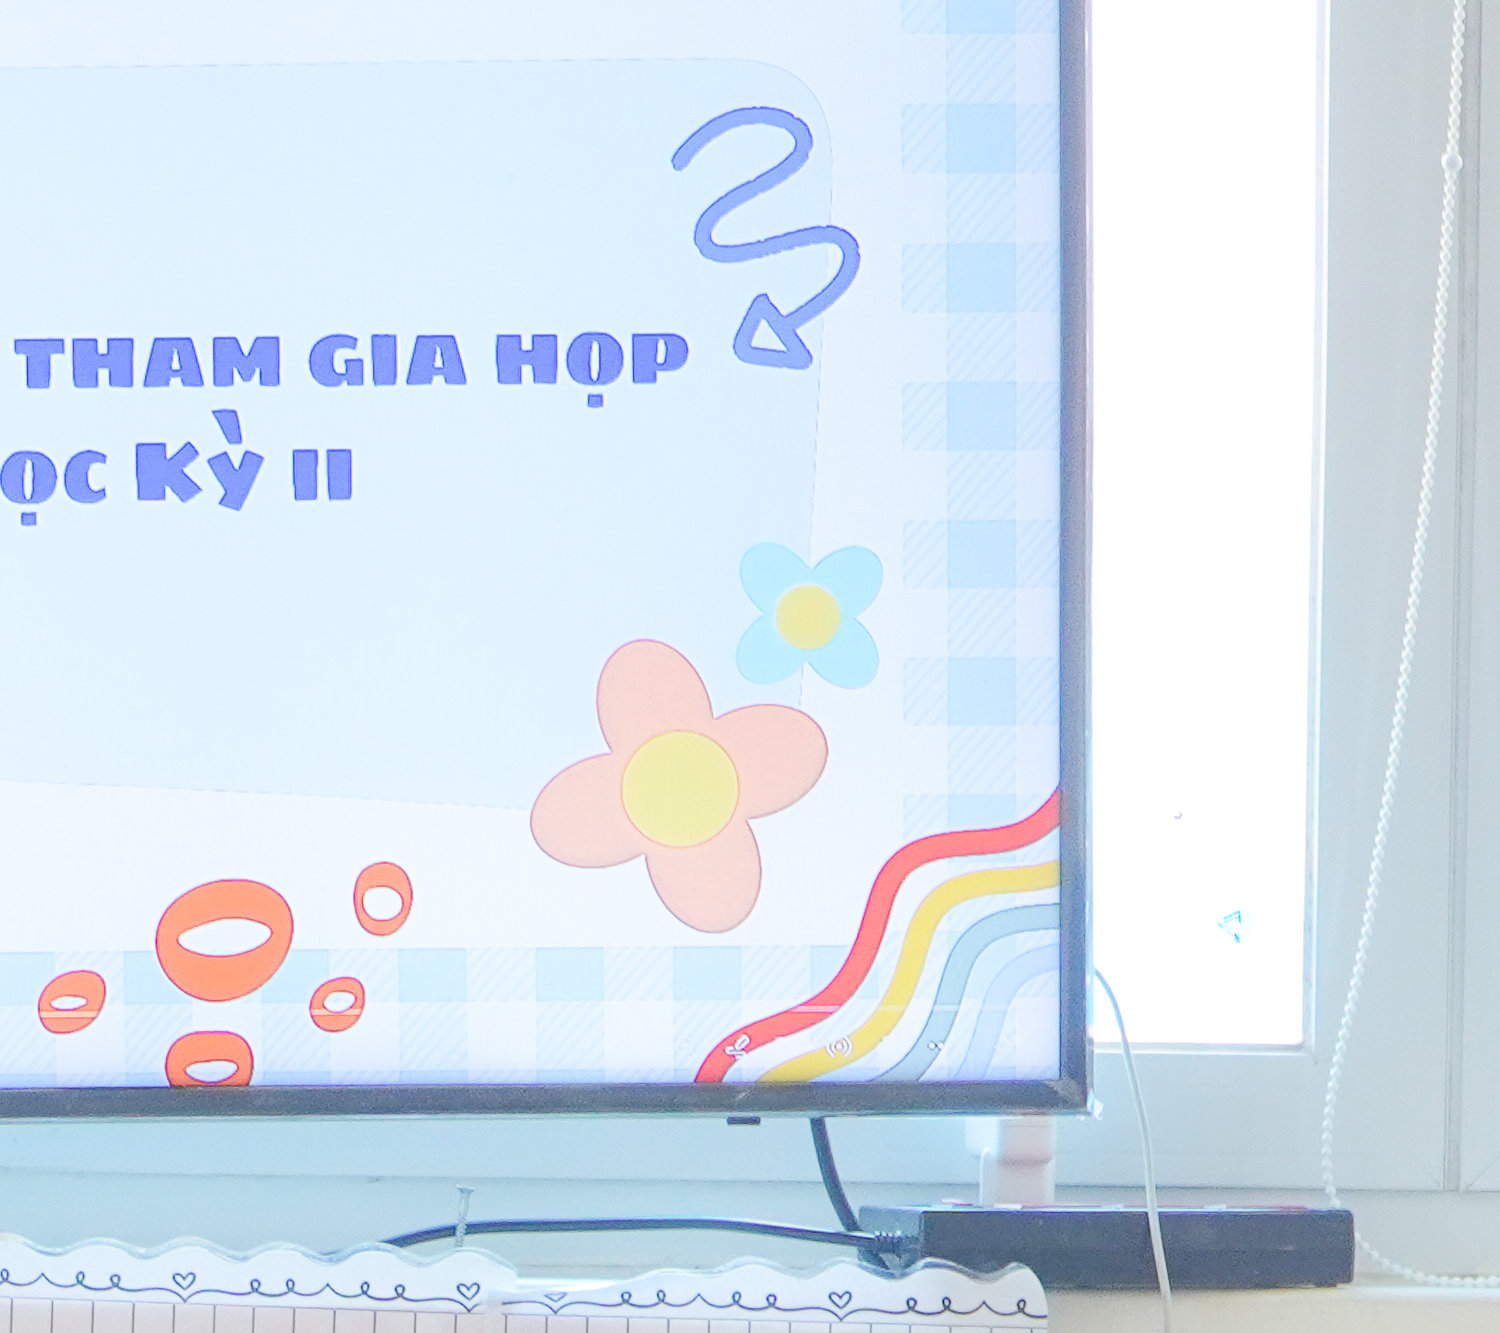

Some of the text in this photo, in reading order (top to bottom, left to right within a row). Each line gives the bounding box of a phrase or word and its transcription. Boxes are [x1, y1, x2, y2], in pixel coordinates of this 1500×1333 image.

[14, 336, 281, 390] THAM
[308, 333, 467, 387] GIA
[495, 331, 689, 408] HỌP
[291, 448, 353, 502] II
